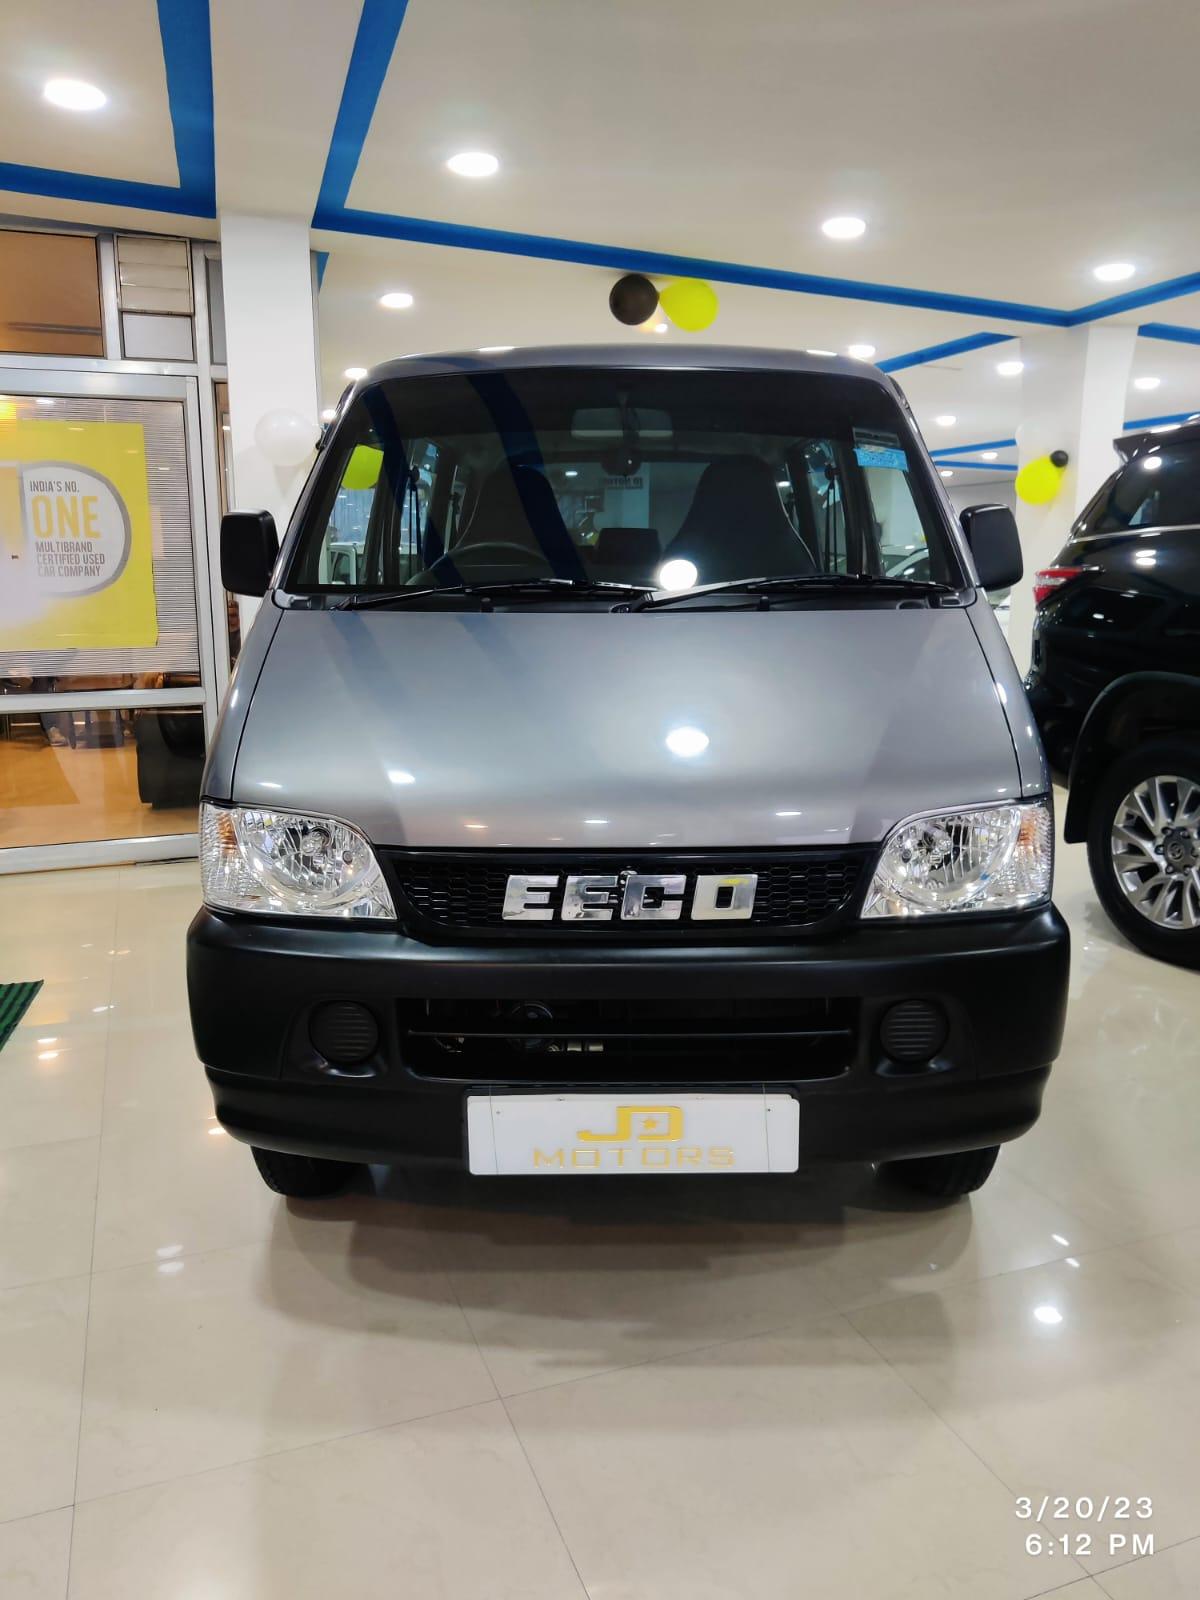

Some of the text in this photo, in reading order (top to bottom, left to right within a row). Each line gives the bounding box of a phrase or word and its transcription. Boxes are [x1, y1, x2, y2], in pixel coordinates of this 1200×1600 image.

[30, 480, 80, 492] INDIA'S NO.
[31, 495, 101, 539] ONE
[35, 541, 93, 553] MULTIBRAND
[37, 553, 105, 564] CERTIFIED USED
[38, 565, 101, 577] CAR COMPANY
[502, 874, 758, 921] EECO
[576, 1105, 685, 1142] JD
[533, 1147, 736, 1168] MOTORS
